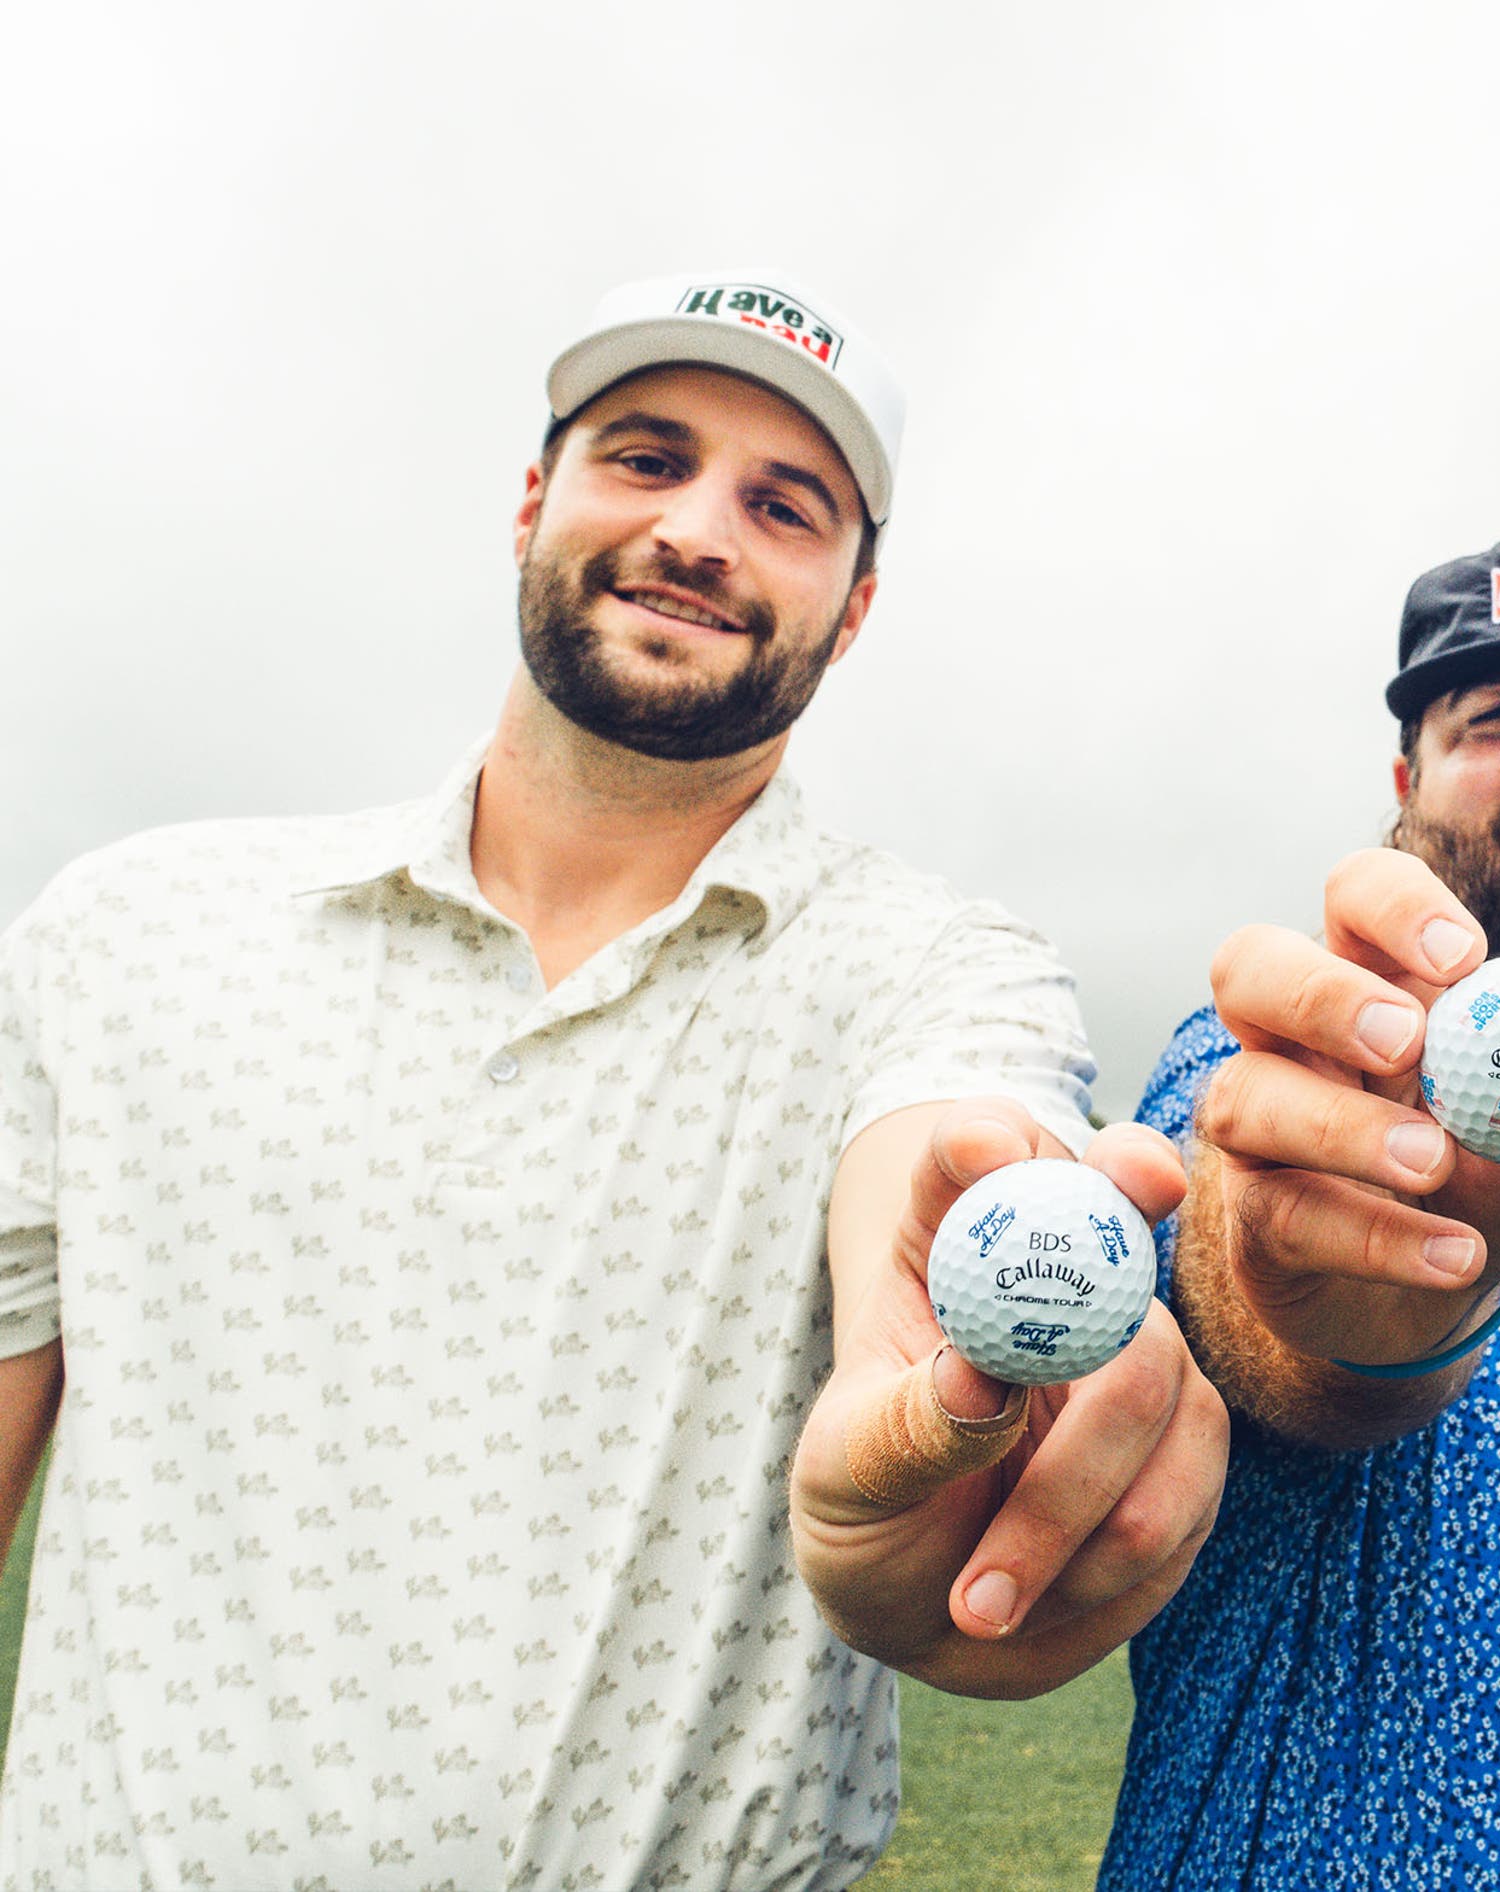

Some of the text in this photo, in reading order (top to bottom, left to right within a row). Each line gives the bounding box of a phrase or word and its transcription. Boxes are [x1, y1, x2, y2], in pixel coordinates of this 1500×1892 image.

[685, 289, 833, 346] Have a
[968, 1202, 1003, 1239] Have
[980, 1206, 1016, 1251] A Day
[1108, 1215, 1130, 1257] Have
[1029, 1232, 1072, 1252] BDS
[1094, 1218, 1120, 1267] A Day
[996, 1258, 1095, 1297] Callaway
[1003, 1294, 1084, 1307] CHROME TOUR
[1011, 1322, 1064, 1342] A Day
[1012, 1340, 1057, 1356] Have
